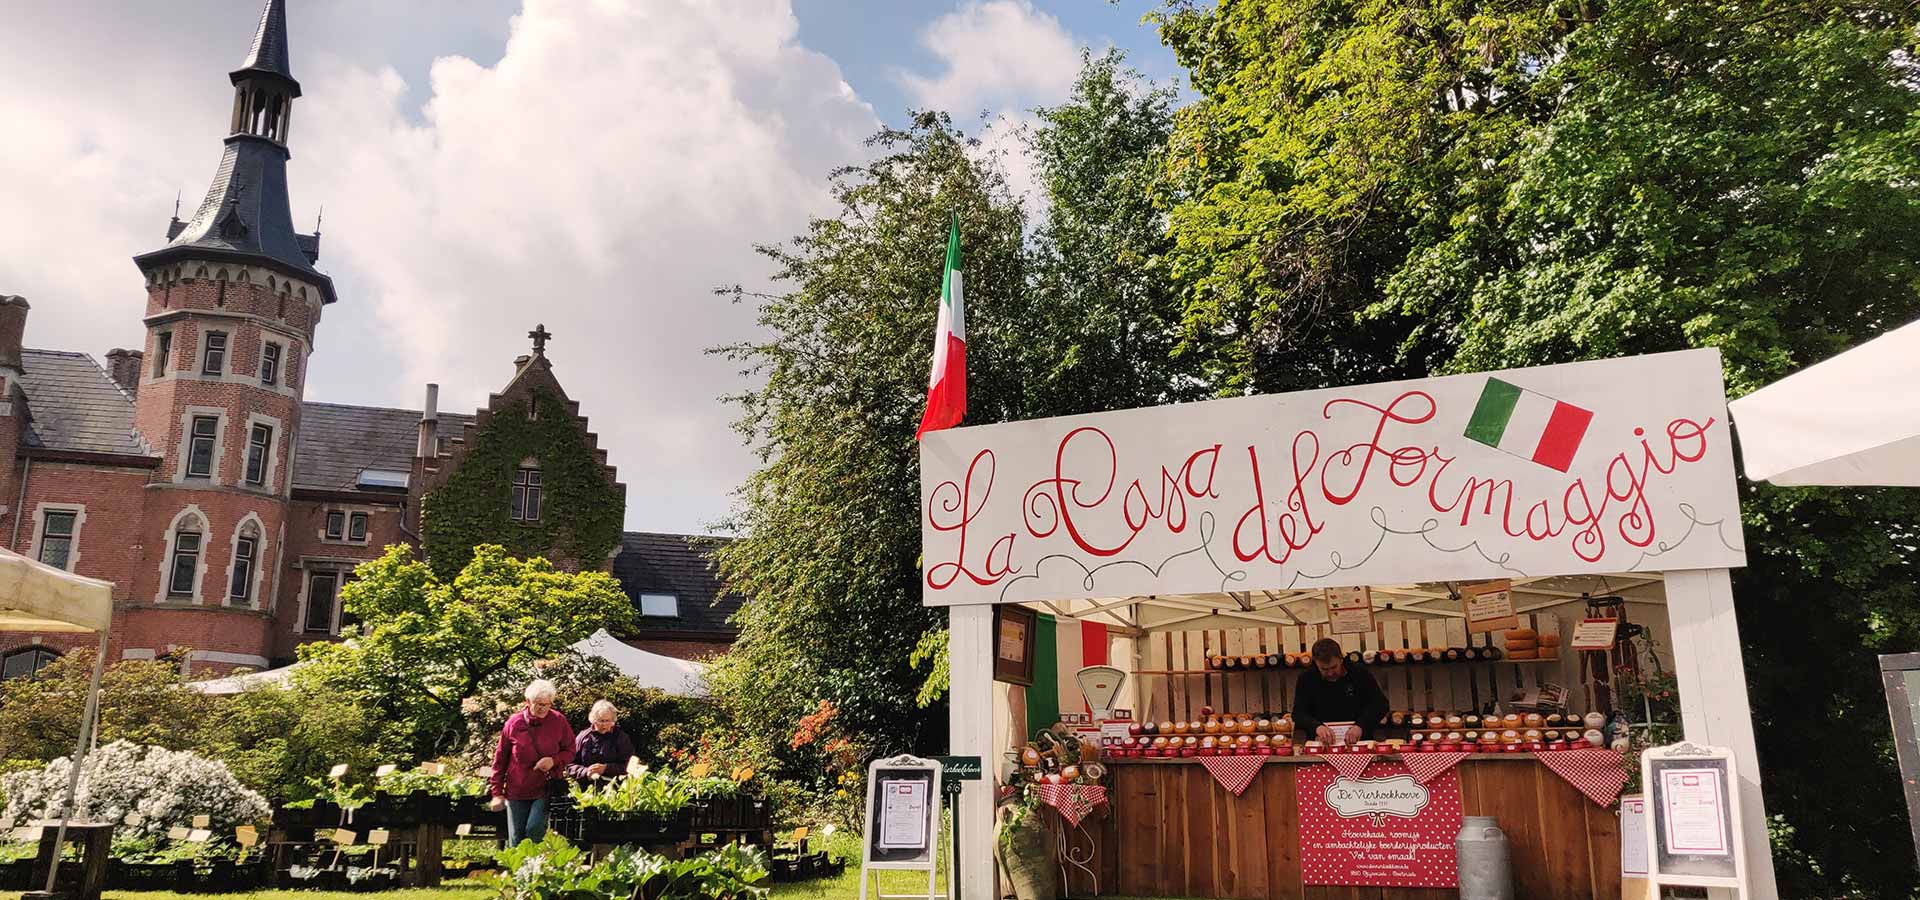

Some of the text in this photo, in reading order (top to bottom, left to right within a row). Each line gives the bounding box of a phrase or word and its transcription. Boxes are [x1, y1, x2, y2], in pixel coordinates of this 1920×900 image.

[926, 390, 1716, 591] La Casa del Formaggio
[1337, 788, 1420, 800] De Vierhoekhoeve
[1349, 851, 1365, 860] Vol
